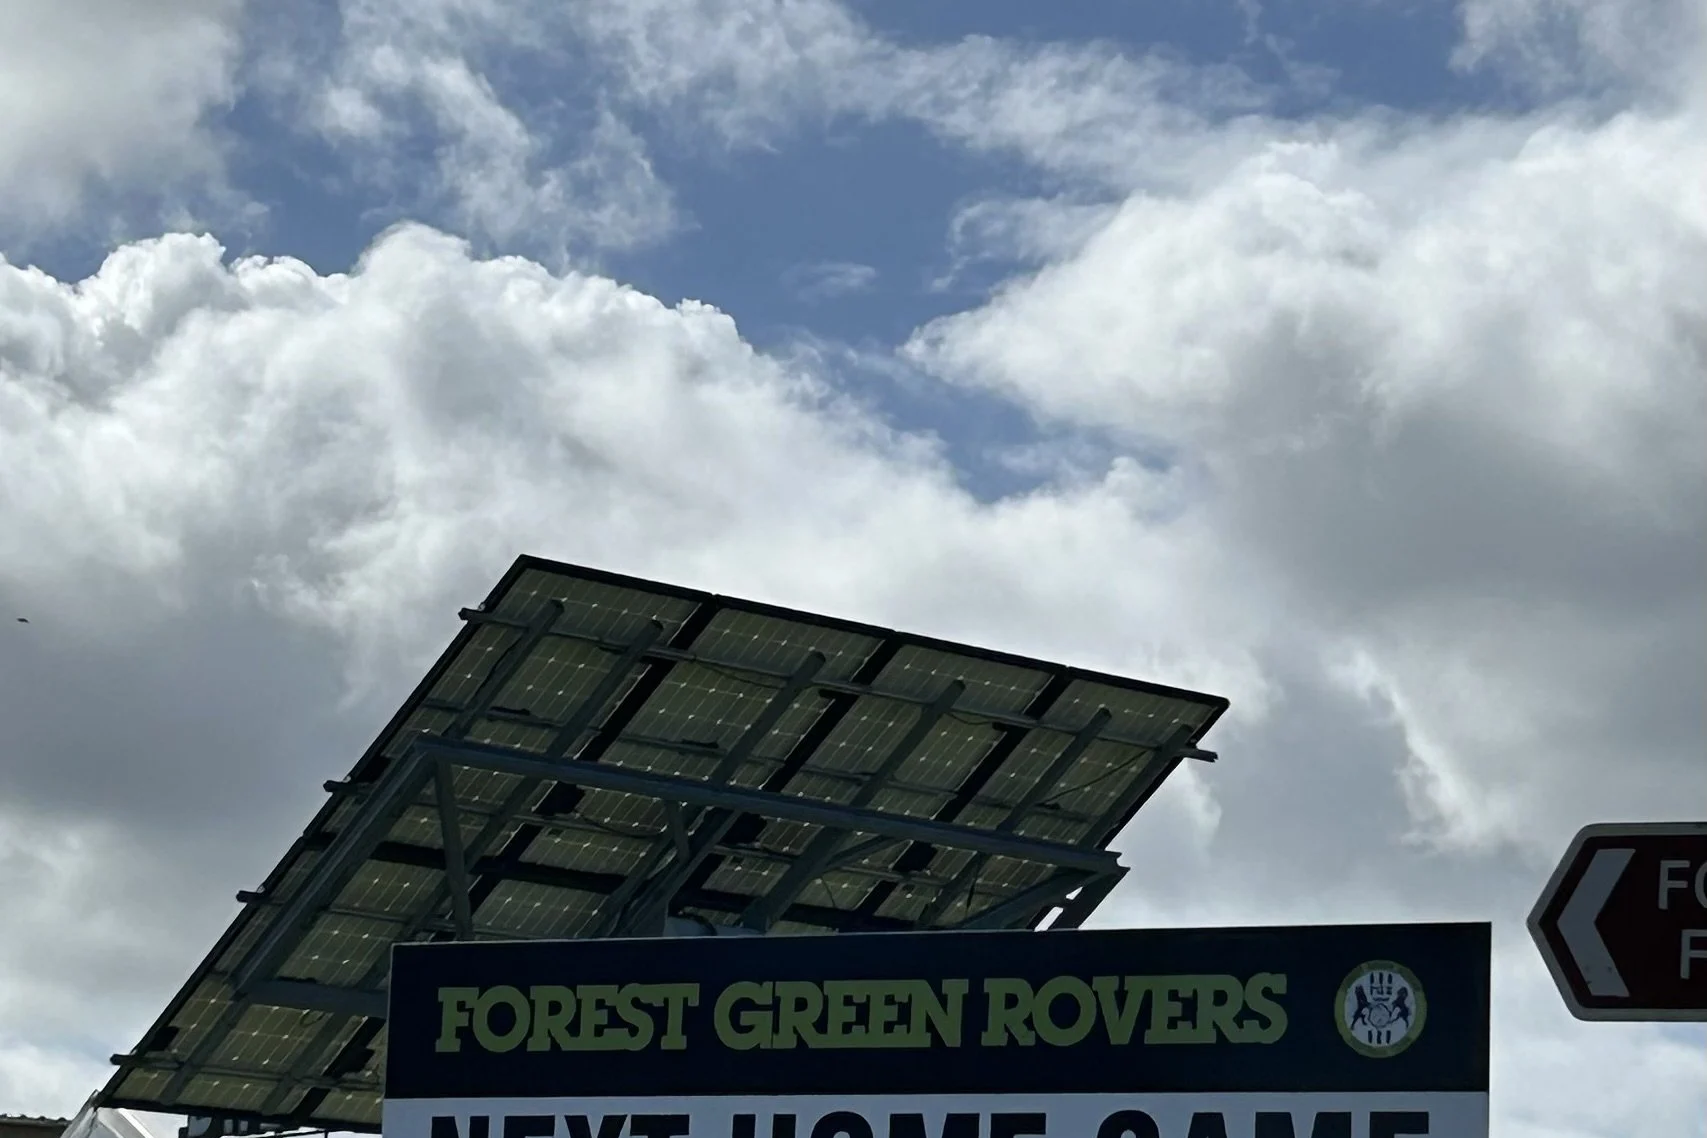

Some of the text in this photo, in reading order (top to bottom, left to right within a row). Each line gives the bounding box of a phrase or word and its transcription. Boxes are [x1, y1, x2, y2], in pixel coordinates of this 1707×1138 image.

[1658, 860, 1707, 910] F
[436, 983, 700, 1054] FOREST
[714, 978, 969, 1050] GREEN
[981, 972, 1288, 1047] ROVERS
